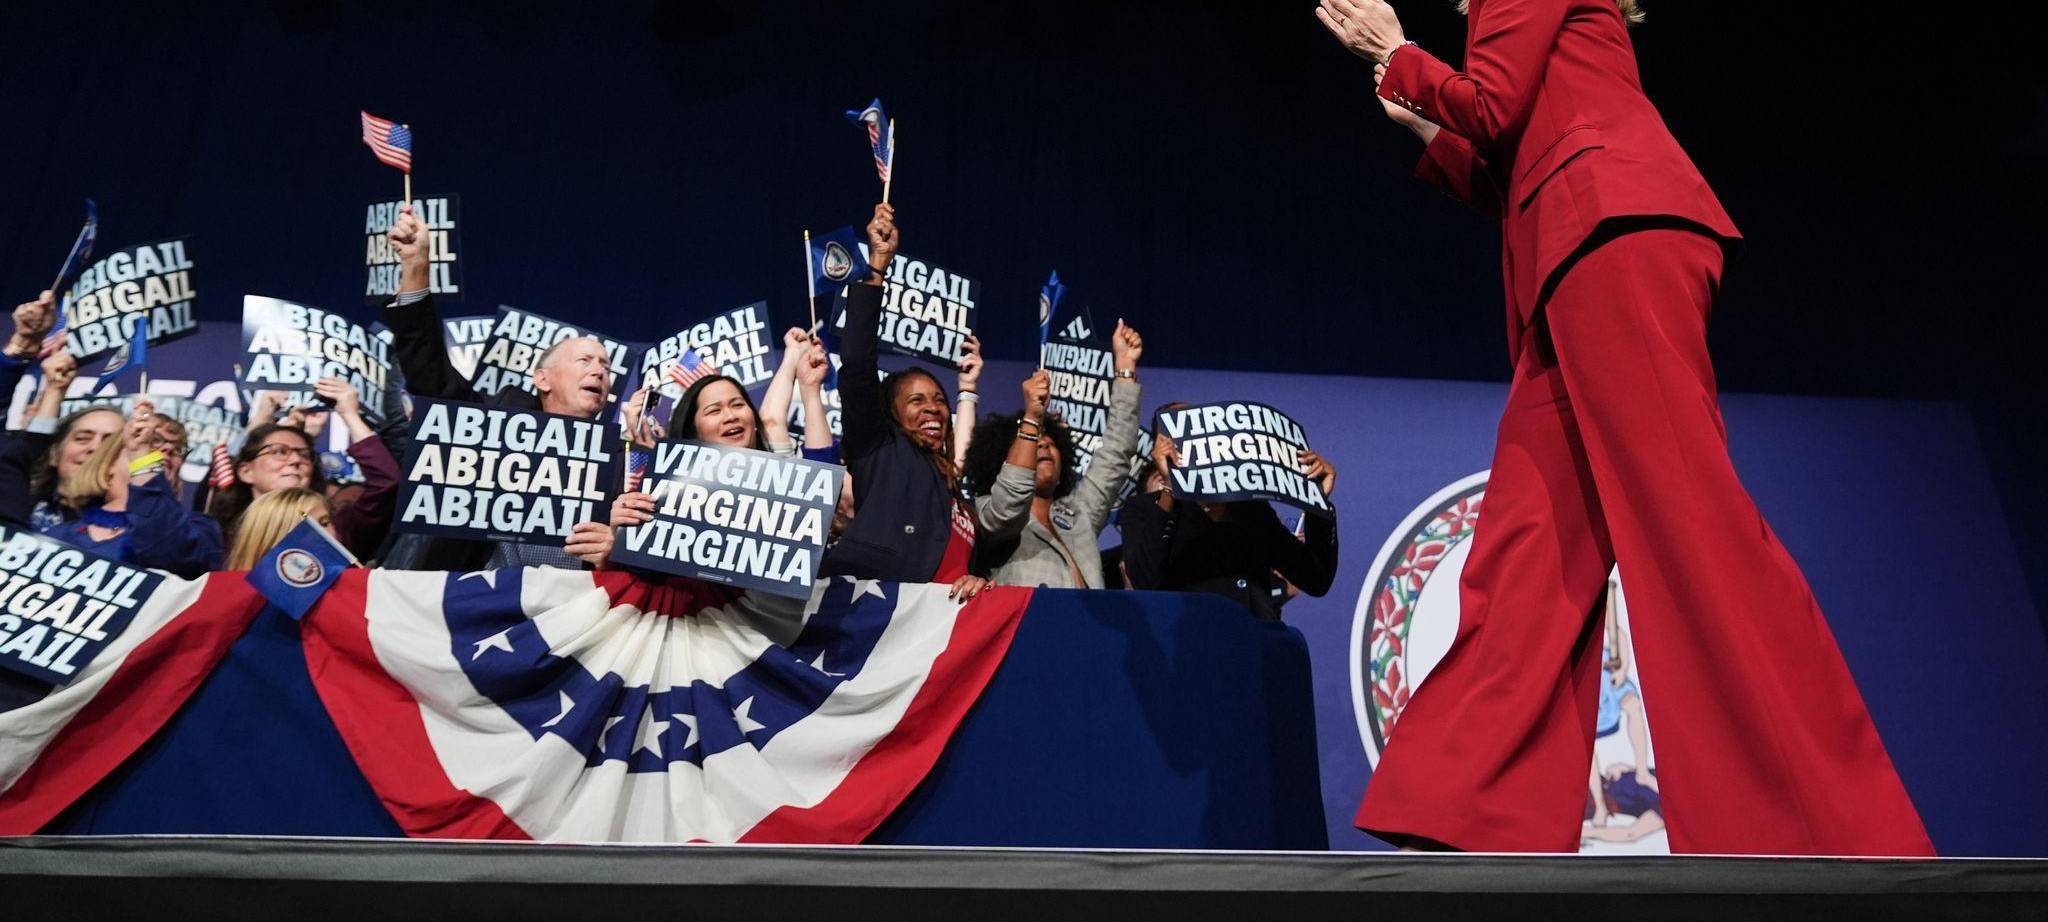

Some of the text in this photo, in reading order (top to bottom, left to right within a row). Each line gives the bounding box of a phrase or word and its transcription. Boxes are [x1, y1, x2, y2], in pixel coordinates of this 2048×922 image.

[366, 230, 456, 265] ABIIL
[858, 242, 975, 309] IGAIL
[366, 262, 459, 296] ABIIL
[841, 281, 972, 335] IGAIL
[283, 303, 392, 370] BIGAIL
[494, 310, 628, 375] ABIIL
[641, 307, 765, 374] ABIGAIL
[836, 310, 968, 368] IGAIL
[415, 403, 610, 463] ABIGAIL
[1160, 403, 1310, 451] VIRGINIA
[1178, 432, 1310, 474] IRGINI
[408, 443, 605, 501] ABIGAIL
[653, 442, 834, 506] VIRGINIA
[1170, 462, 1329, 510] VIRGINIA
[625, 519, 811, 587] VIRGINIA
[0, 570, 119, 642] IGAIL
